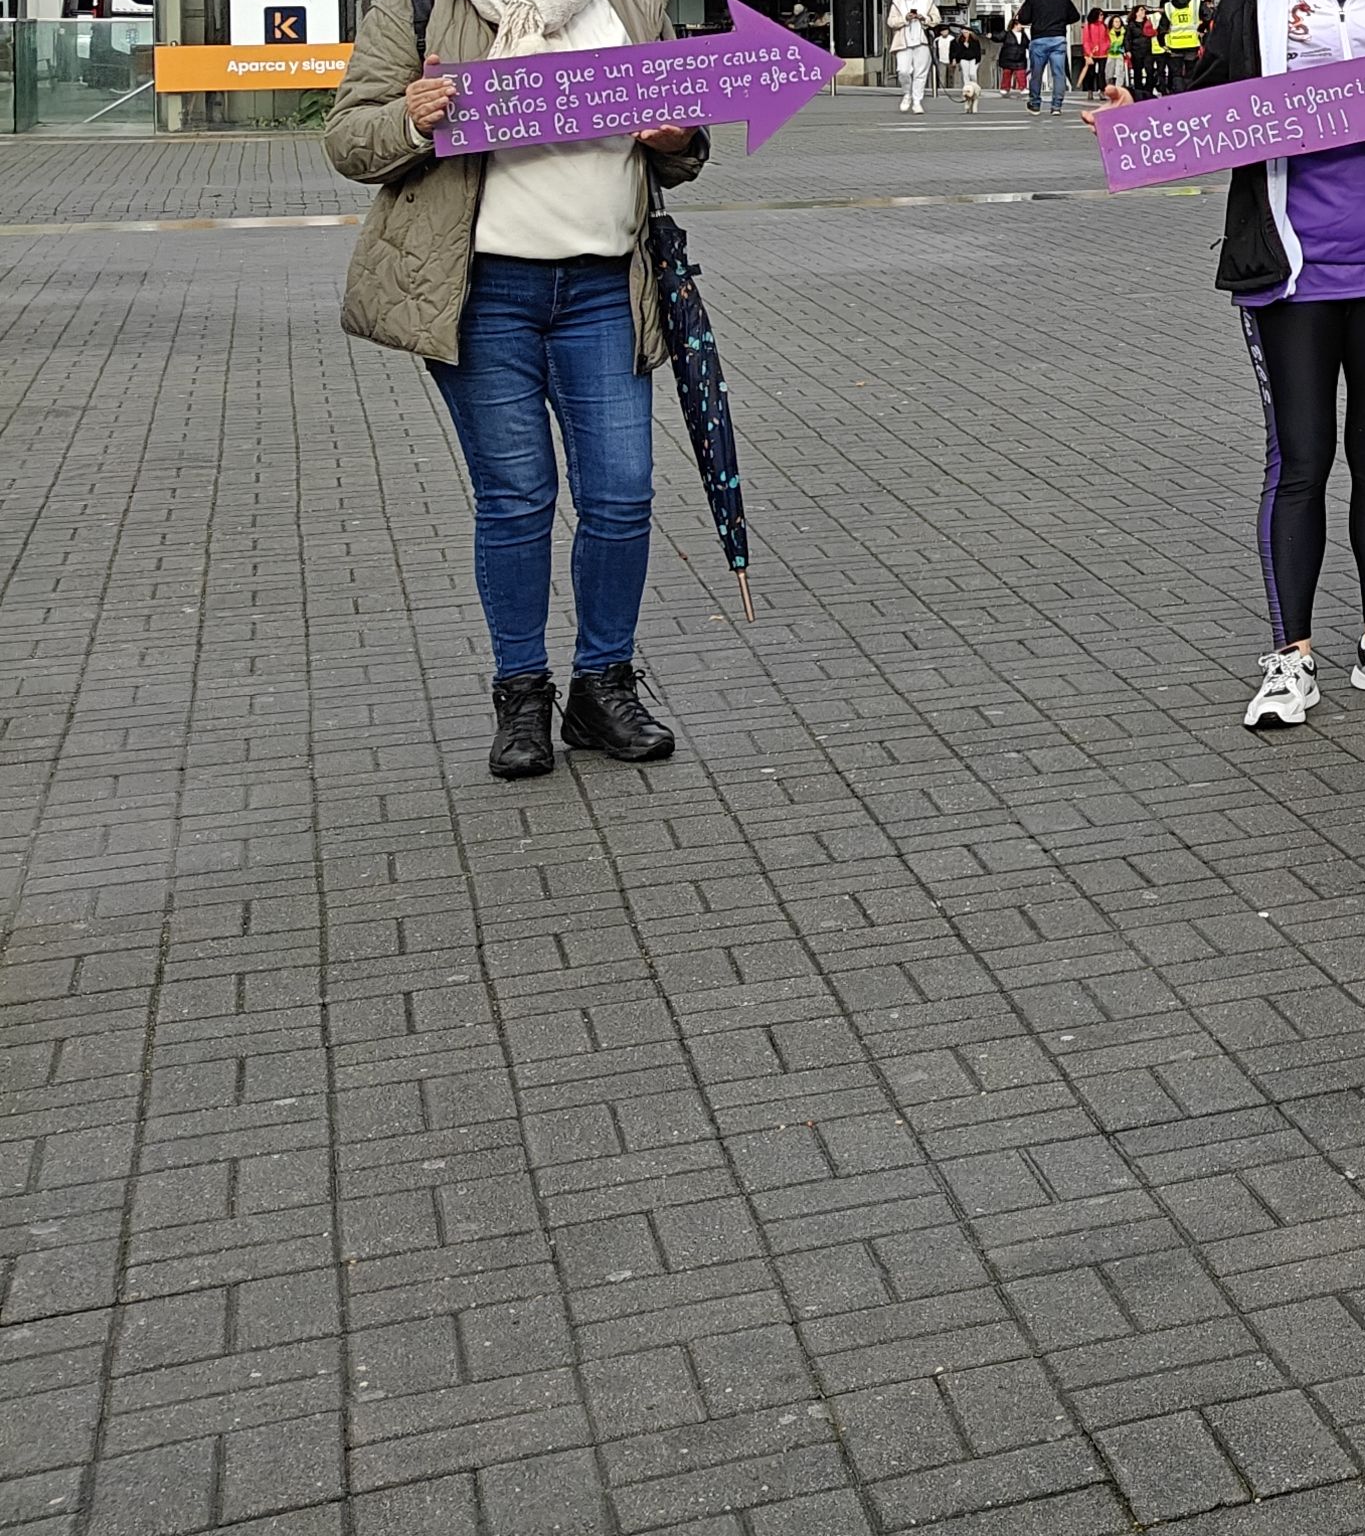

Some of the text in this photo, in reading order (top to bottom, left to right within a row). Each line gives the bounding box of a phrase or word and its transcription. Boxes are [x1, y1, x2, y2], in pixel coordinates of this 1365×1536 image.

[226, 58, 346, 76] Aparca y sigue
[446, 62, 823, 124] los niños es una herida que afecta
[484, 67, 544, 93] daño
[555, 67, 596, 95] que
[603, 63, 634, 79] un
[641, 52, 719, 82] agresor
[722, 47, 782, 66] causa
[786, 45, 802, 60] a
[451, 99, 712, 147] a toda la sociedad.
[1112, 113, 1212, 148] Proteger
[1225, 107, 1241, 123] a
[1250, 94, 1275, 118] la
[1120, 153, 1136, 171] a
[1140, 143, 1176, 167] las
[1192, 117, 1304, 158] MADRES
